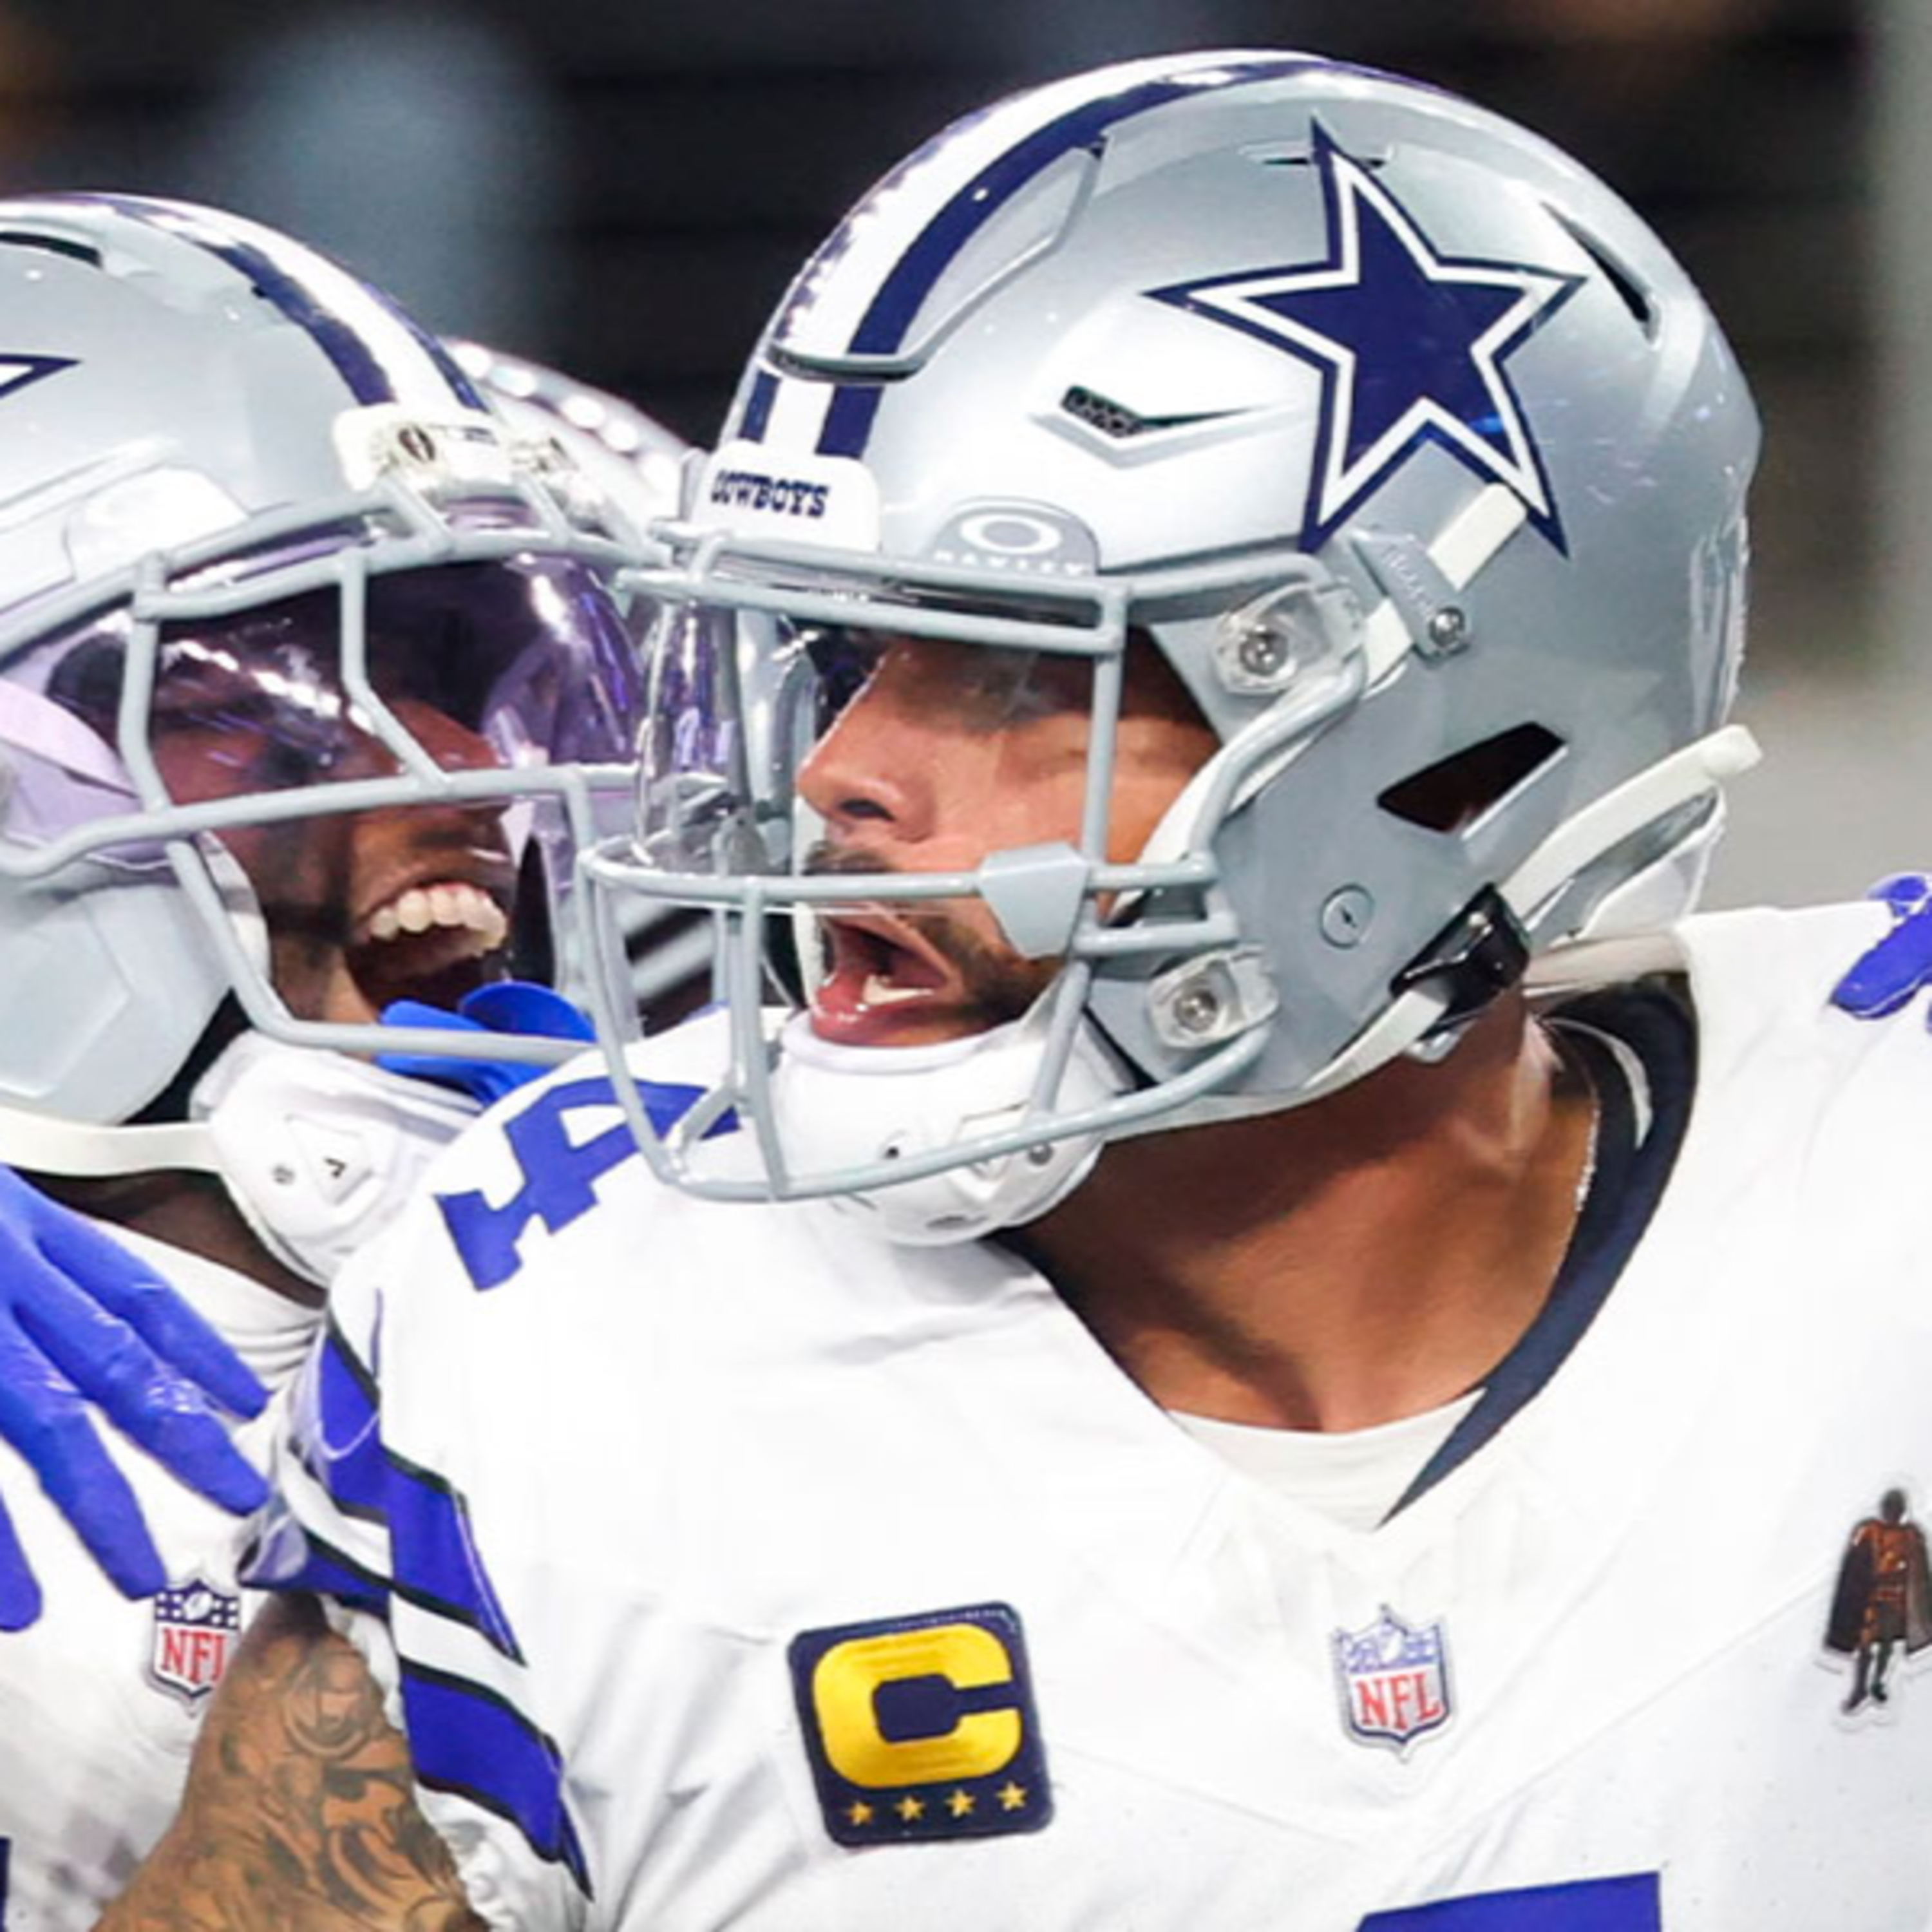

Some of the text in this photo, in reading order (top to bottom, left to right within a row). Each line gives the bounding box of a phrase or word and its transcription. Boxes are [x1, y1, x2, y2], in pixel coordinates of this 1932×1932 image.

[433, 1077, 742, 1293] 4
[812, 1622, 1023, 1789] C
[1355, 1671, 1441, 1731] NFL
